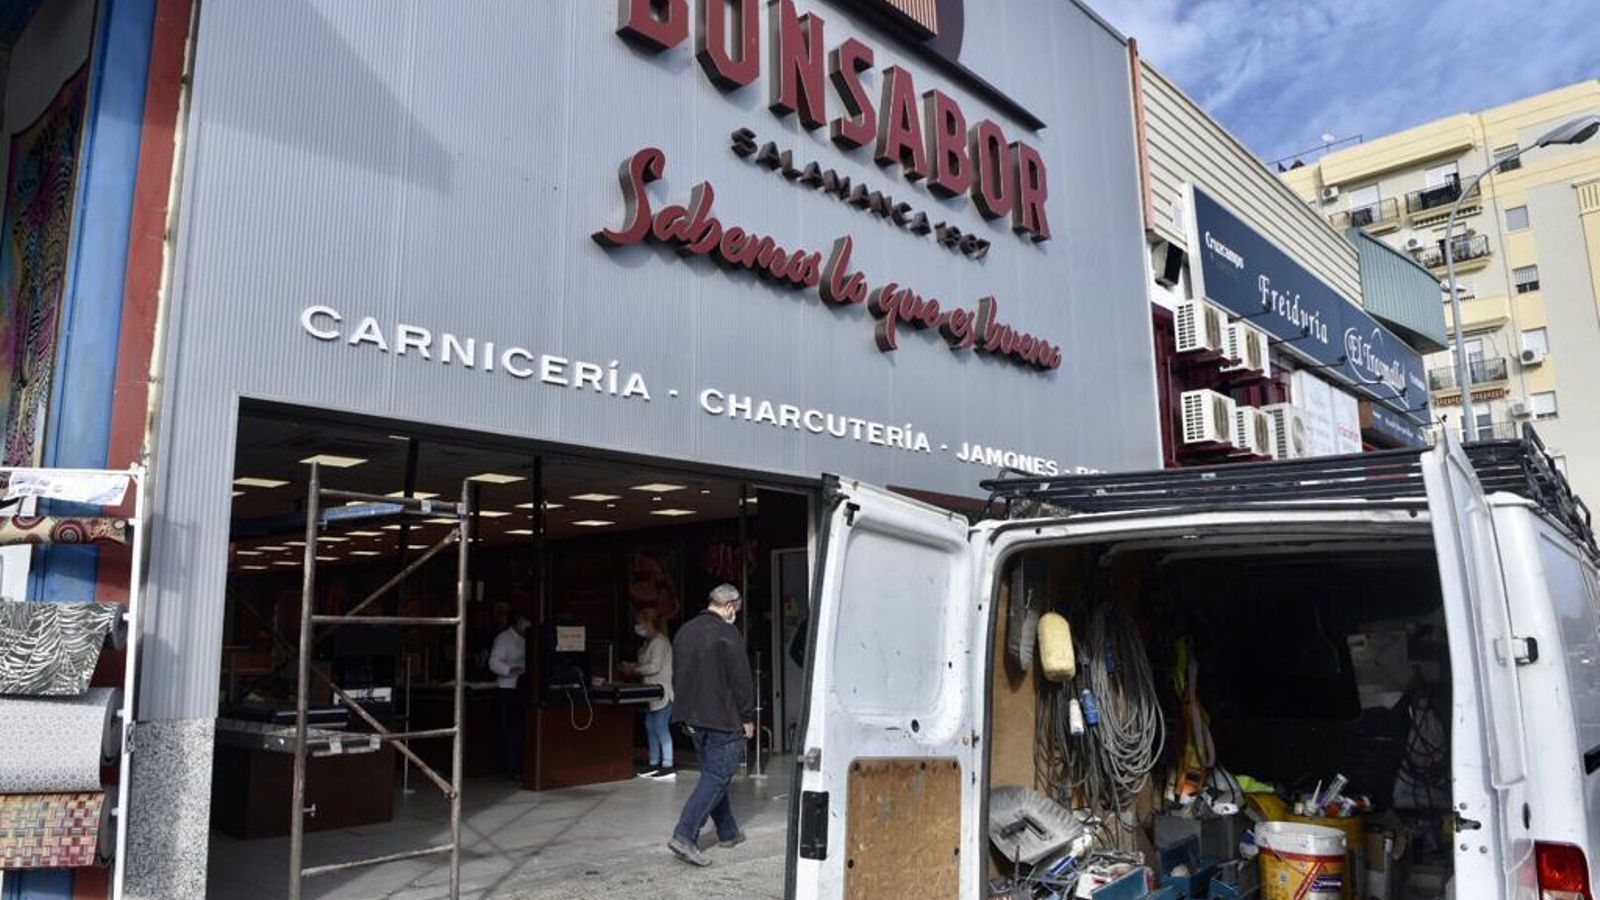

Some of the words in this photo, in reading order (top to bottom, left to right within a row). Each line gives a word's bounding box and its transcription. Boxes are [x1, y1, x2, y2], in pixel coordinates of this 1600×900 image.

[592, 147, 823, 290] Sabemos
[819, 234, 867, 309] lo
[868, 283, 942, 353] que
[939, 307, 975, 350] es
[973, 292, 1062, 371] bueno
[731, 127, 931, 236] SALAMANCA
[300, 304, 651, 401] CARNICERÍA
[699, 387, 931, 454] CHARCUTERÍA
[956, 441, 1059, 477] JAMONES
